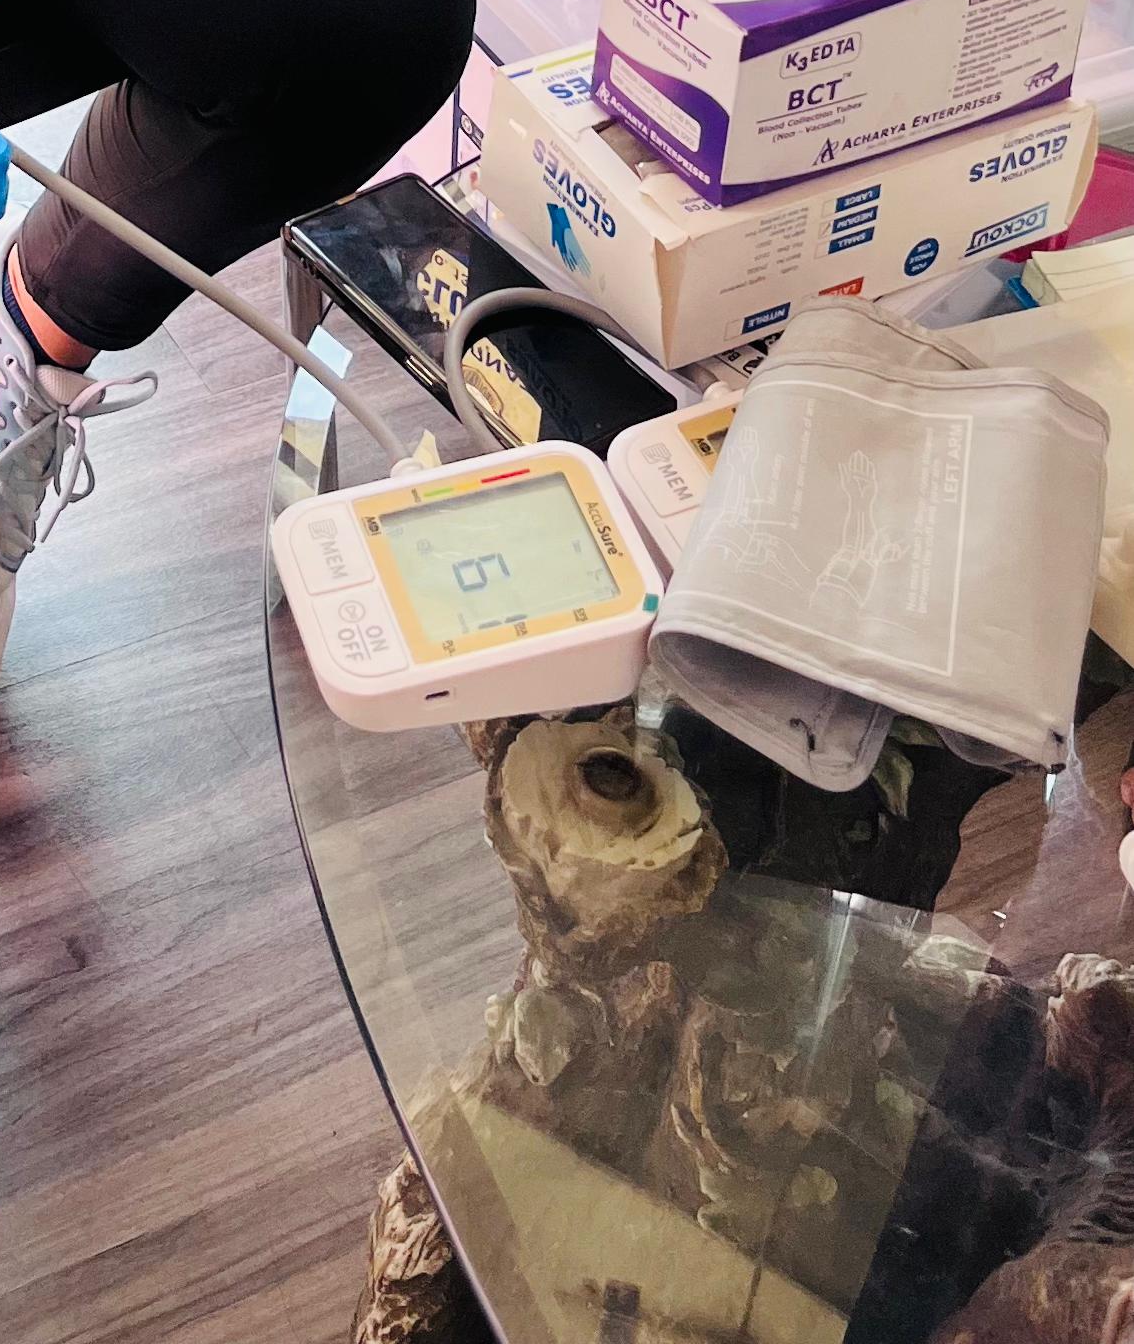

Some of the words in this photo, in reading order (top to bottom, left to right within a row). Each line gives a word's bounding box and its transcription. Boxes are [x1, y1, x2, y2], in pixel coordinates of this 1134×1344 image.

[787, 78, 844, 111] BCT
[786, 110, 834, 130] Collection
[836, 100, 863, 118] Tubes
[841, 121, 907, 152] ACHARYA
[969, 135, 1068, 183] GLOVES
[532, 138, 617, 239] GLOVES
[542, 174, 600, 238] EXAMINATION
[843, 190, 873, 207] LARGE
[836, 211, 874, 229] MEDIUM
[964, 201, 1050, 258] LOCKOUT
[837, 234, 866, 249] SMALL
[748, 307, 786, 328] NITRILE
[949, 423, 963, 460] ARM
[657, 461, 695, 503] MEM
[944, 463, 960, 503] LEFT
[321, 540, 349, 581] MEM
[337, 628, 364, 664] OFF
[364, 623, 390, 654] ON
